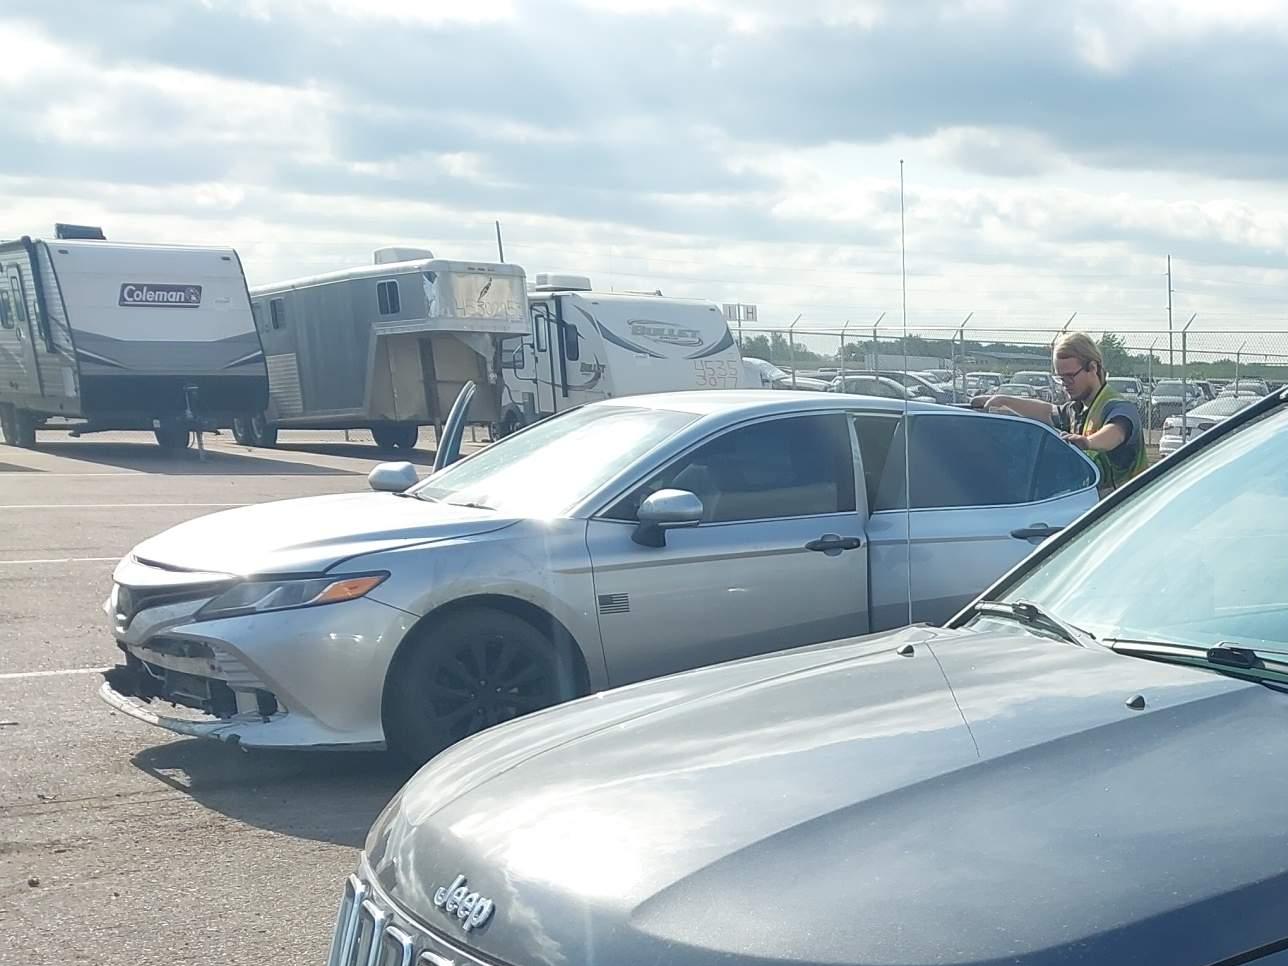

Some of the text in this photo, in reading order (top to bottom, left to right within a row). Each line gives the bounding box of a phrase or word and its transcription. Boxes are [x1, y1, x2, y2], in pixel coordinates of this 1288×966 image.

[123, 285, 185, 302] Coleman
[746, 307, 754, 320] H
[434, 874, 493, 931] Jeep
